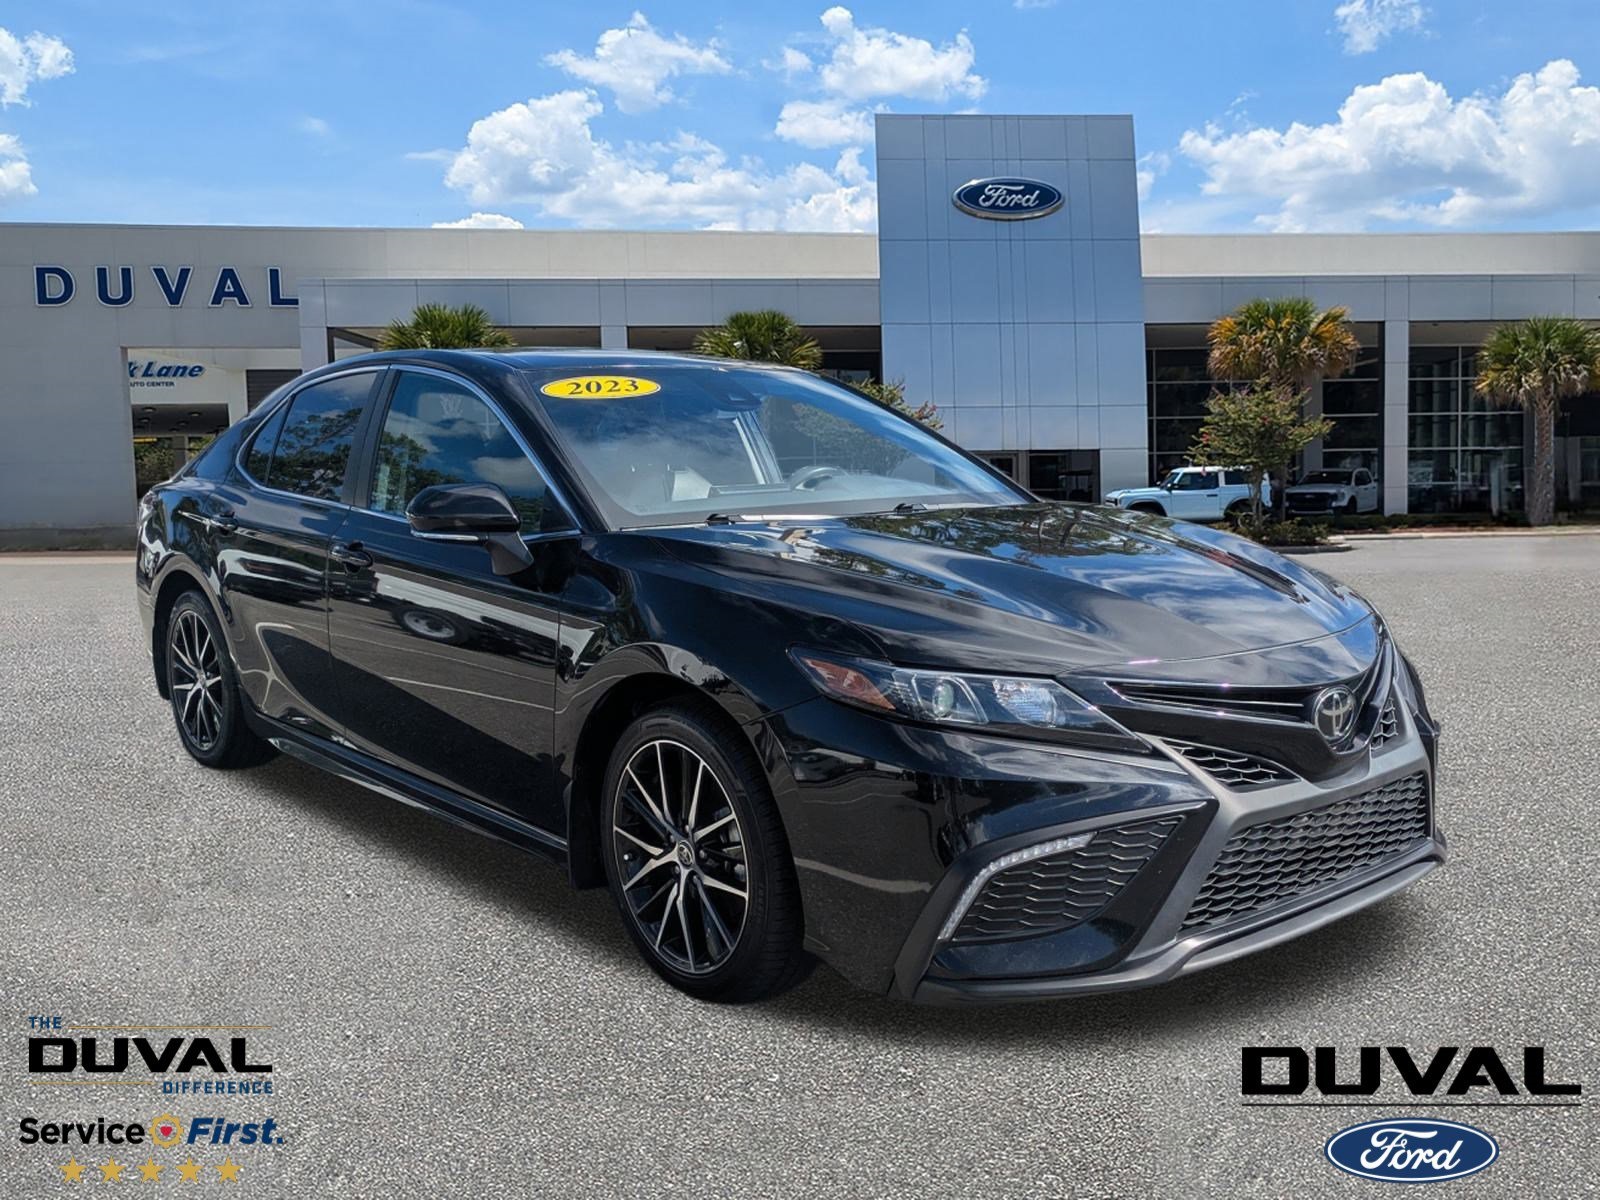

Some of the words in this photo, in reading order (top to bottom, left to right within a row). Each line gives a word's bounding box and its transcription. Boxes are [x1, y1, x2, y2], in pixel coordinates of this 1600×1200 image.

[979, 185, 1040, 206] Ford
[34, 265, 299, 307] DUVAL
[142, 361, 205, 377] Lane
[566, 380, 639, 394] 2023
